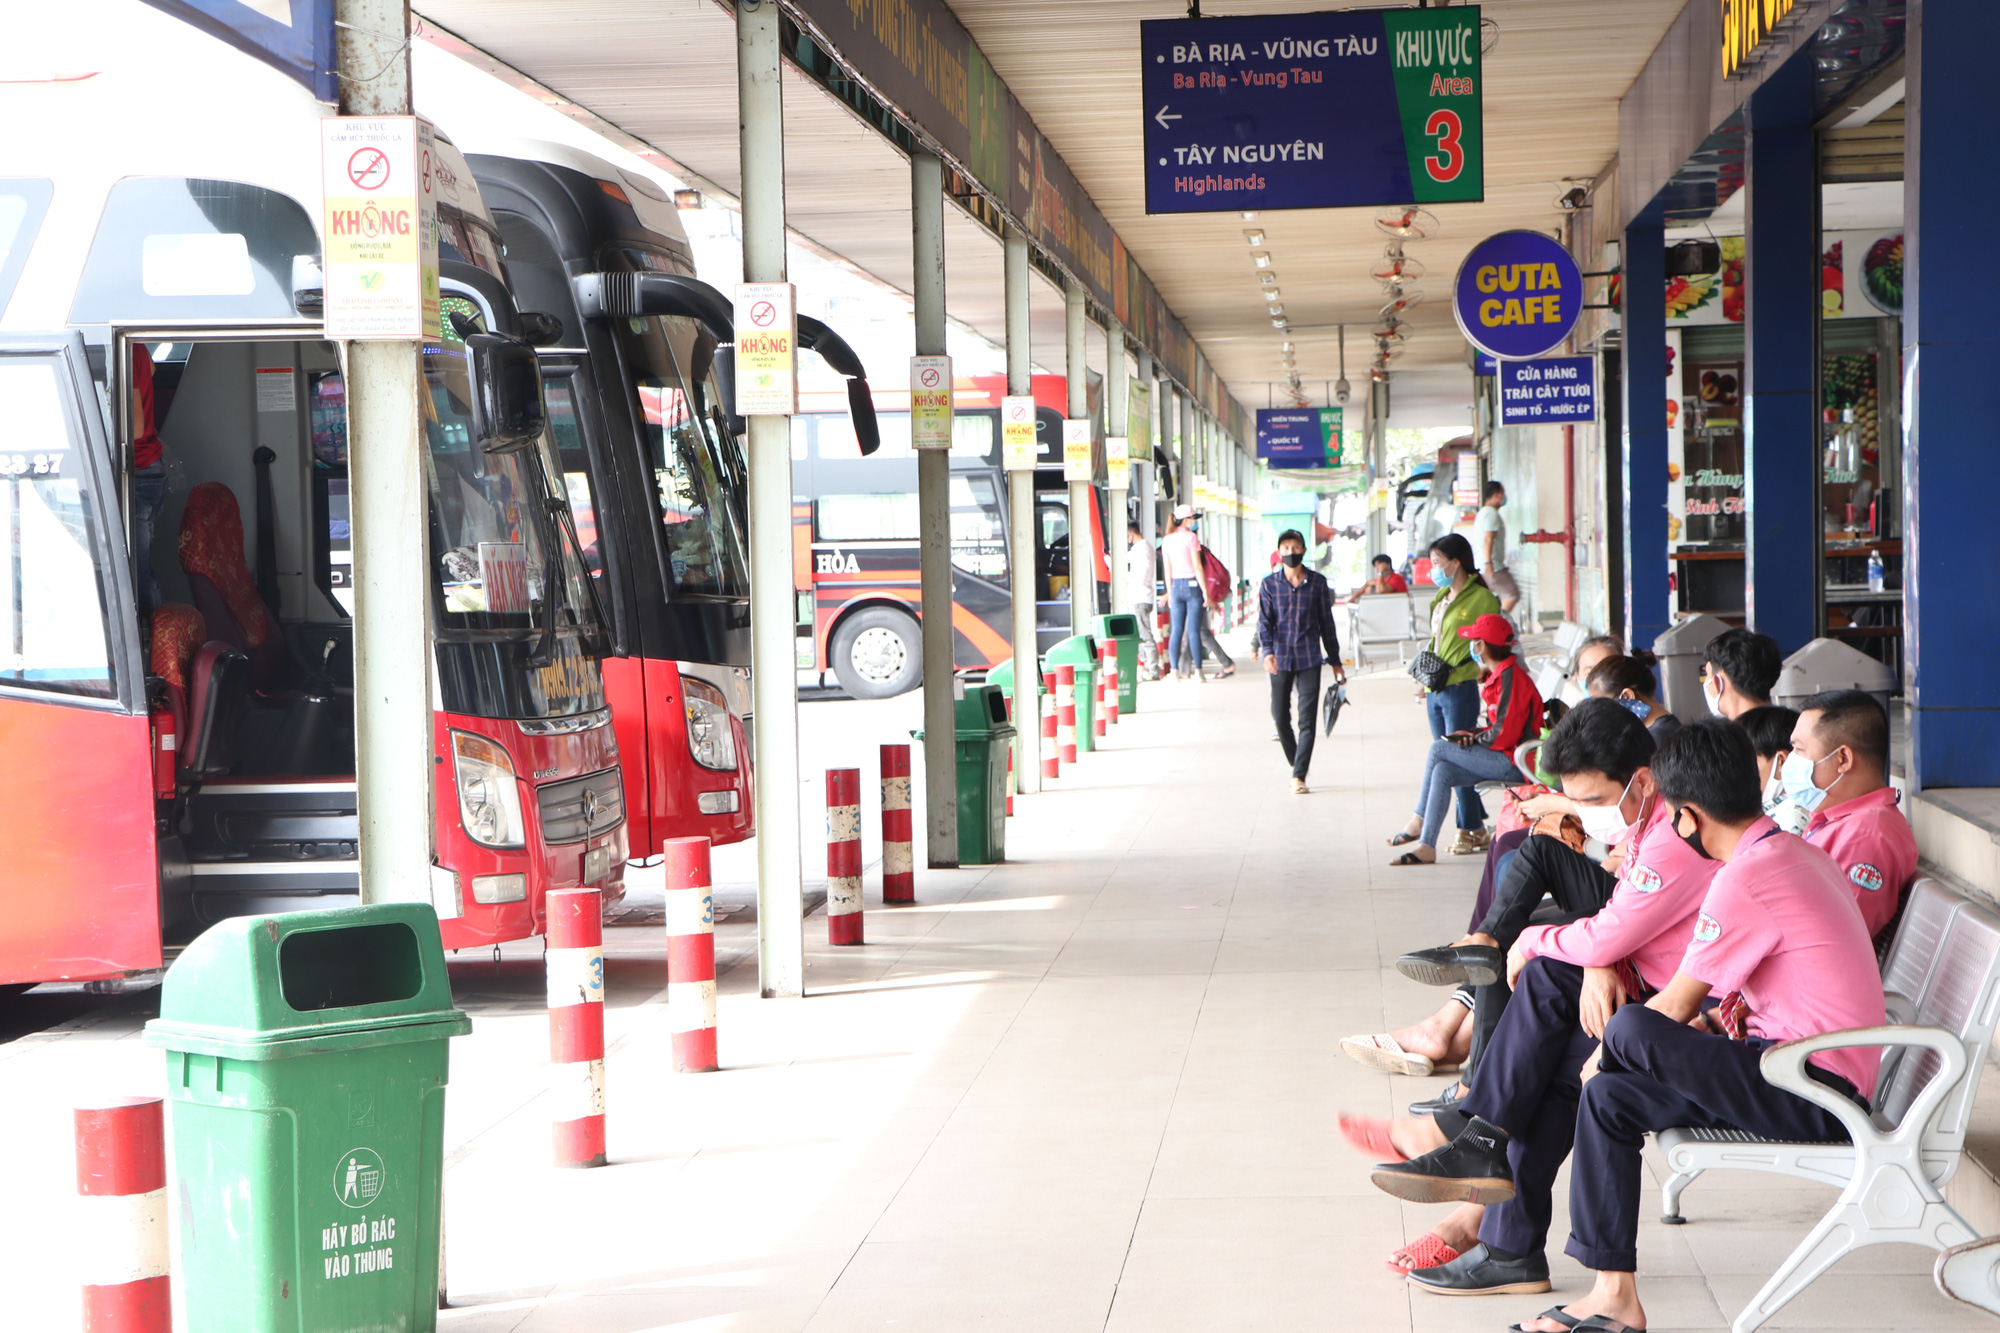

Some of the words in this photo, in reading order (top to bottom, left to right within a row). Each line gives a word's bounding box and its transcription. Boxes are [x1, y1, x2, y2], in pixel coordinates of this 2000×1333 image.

[1172, 42, 1202, 64] BÀ
[1209, 43, 1246, 66] RỊA
[1263, 37, 1329, 60] VŨNG
[1334, 35, 1378, 57] TÀU
[1396, 30, 1432, 68] KHU
[1436, 23, 1473, 76] VỰC
[922, 12, 937, 98] TÂY
[940, 48, 968, 128] NGUYÊN
[1173, 73, 1195, 89] Ba
[1200, 71, 1226, 88] Ria
[1241, 70, 1288, 88] Vung
[1290, 68, 1323, 84] Tau
[1430, 74, 1474, 96] Area
[331, 134, 346, 142] CẤM
[367, 134, 390, 142] THUỐC
[368, 122, 386, 132] VỰC
[1174, 144, 1217, 166] TÂY
[1222, 140, 1324, 165] NGUYÊN
[1424, 108, 1464, 183] 3
[1174, 174, 1266, 196] Highlands
[332, 200, 410, 238] KHÔNG
[1476, 262, 1562, 294] GUTA
[1479, 294, 1562, 328] CAFE
[741, 332, 788, 355] KHÔNG
[1516, 365, 1542, 381] CỬA
[1544, 366, 1578, 380] HÀNG
[914, 391, 948, 408] KHÔNG
[1504, 385, 1532, 400] TRÁI
[1536, 384, 1560, 398] CÂY
[1562, 384, 1590, 397] TƯƠI
[1506, 406, 1528, 416] SINH
[1530, 403, 1542, 416] TỐ
[1550, 404, 1576, 414] NƯỚC
[1577, 403, 1590, 414] ÉP
[1328, 432, 1339, 452] 4
[33, 453, 64, 474] 27
[1696, 468, 1744, 489] Hàng
[1686, 498, 1720, 515] Sinh
[816, 549, 860, 574] HÒA
[702, 896, 714, 924] 3
[589, 956, 602, 990] 3
[322, 1223, 348, 1250] HÃY
[351, 1215, 367, 1246] BỎ
[371, 1214, 396, 1242] RÁC
[324, 1252, 349, 1280] VÀO
[354, 1246, 393, 1275] THÙNG
